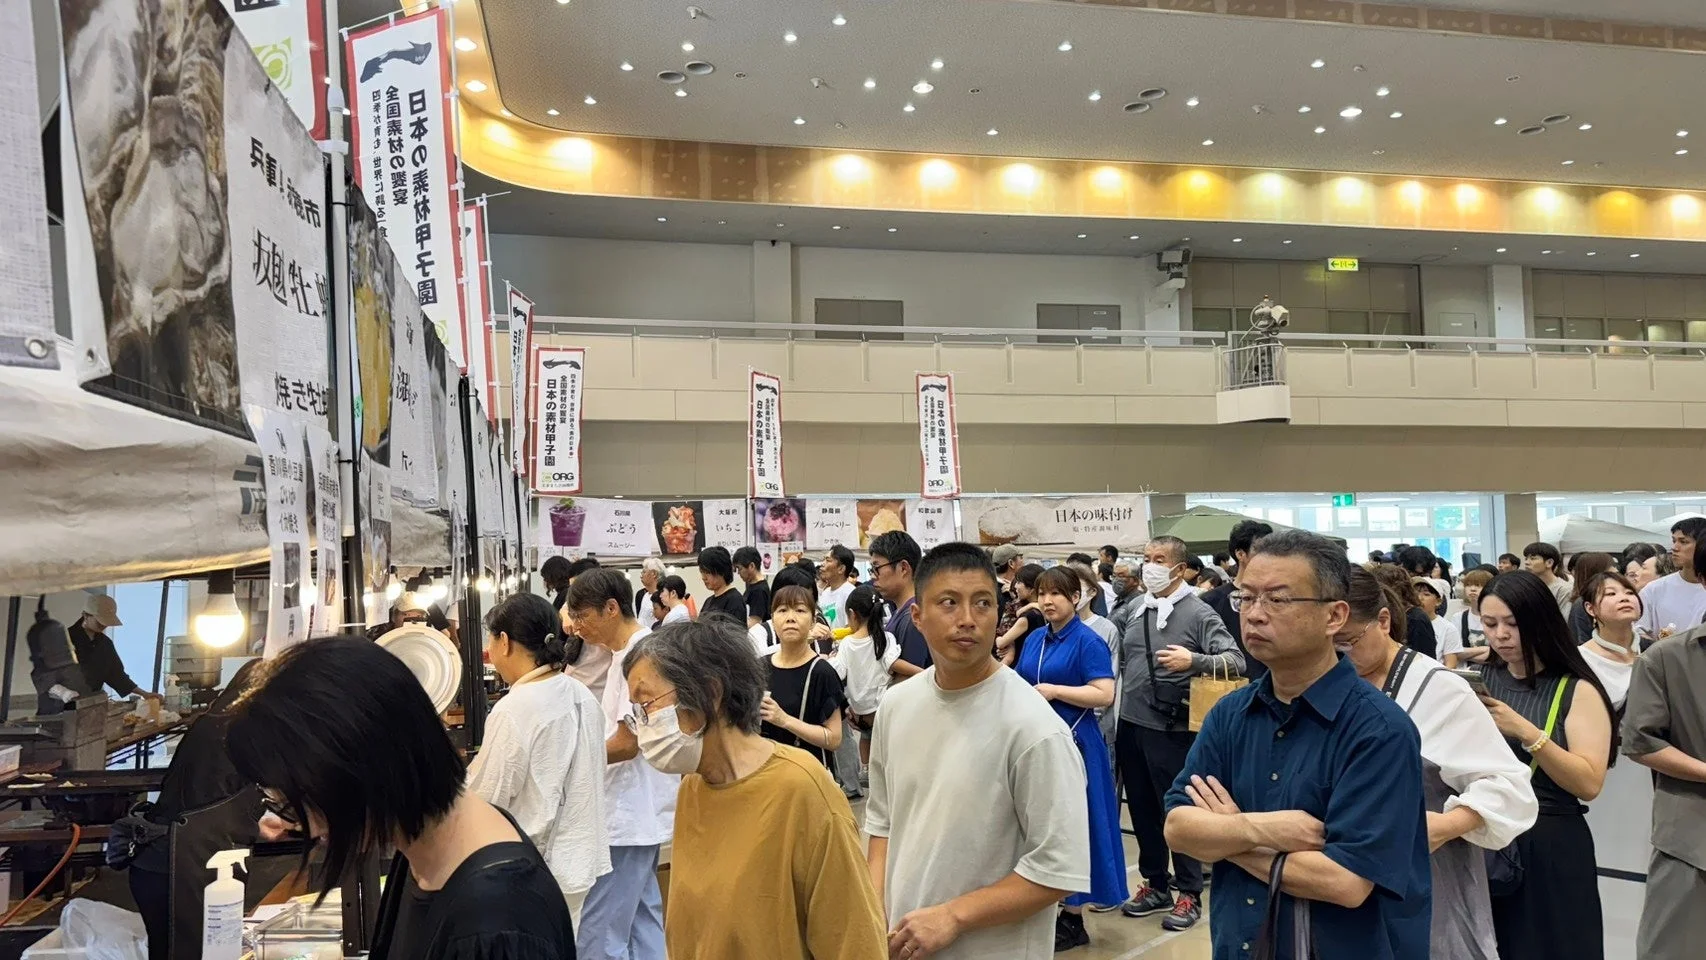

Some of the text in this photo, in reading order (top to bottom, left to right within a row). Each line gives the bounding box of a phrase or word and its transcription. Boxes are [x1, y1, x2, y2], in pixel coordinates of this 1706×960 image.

[544, 379, 557, 466] 日本の素材甲子園
[552, 472, 574, 481] ORG
[1055, 507, 1133, 523] 日本の味付け
[606, 523, 636, 534] ぶどう
[716, 522, 742, 532] いちご
[813, 520, 851, 529] ブルーベリー
